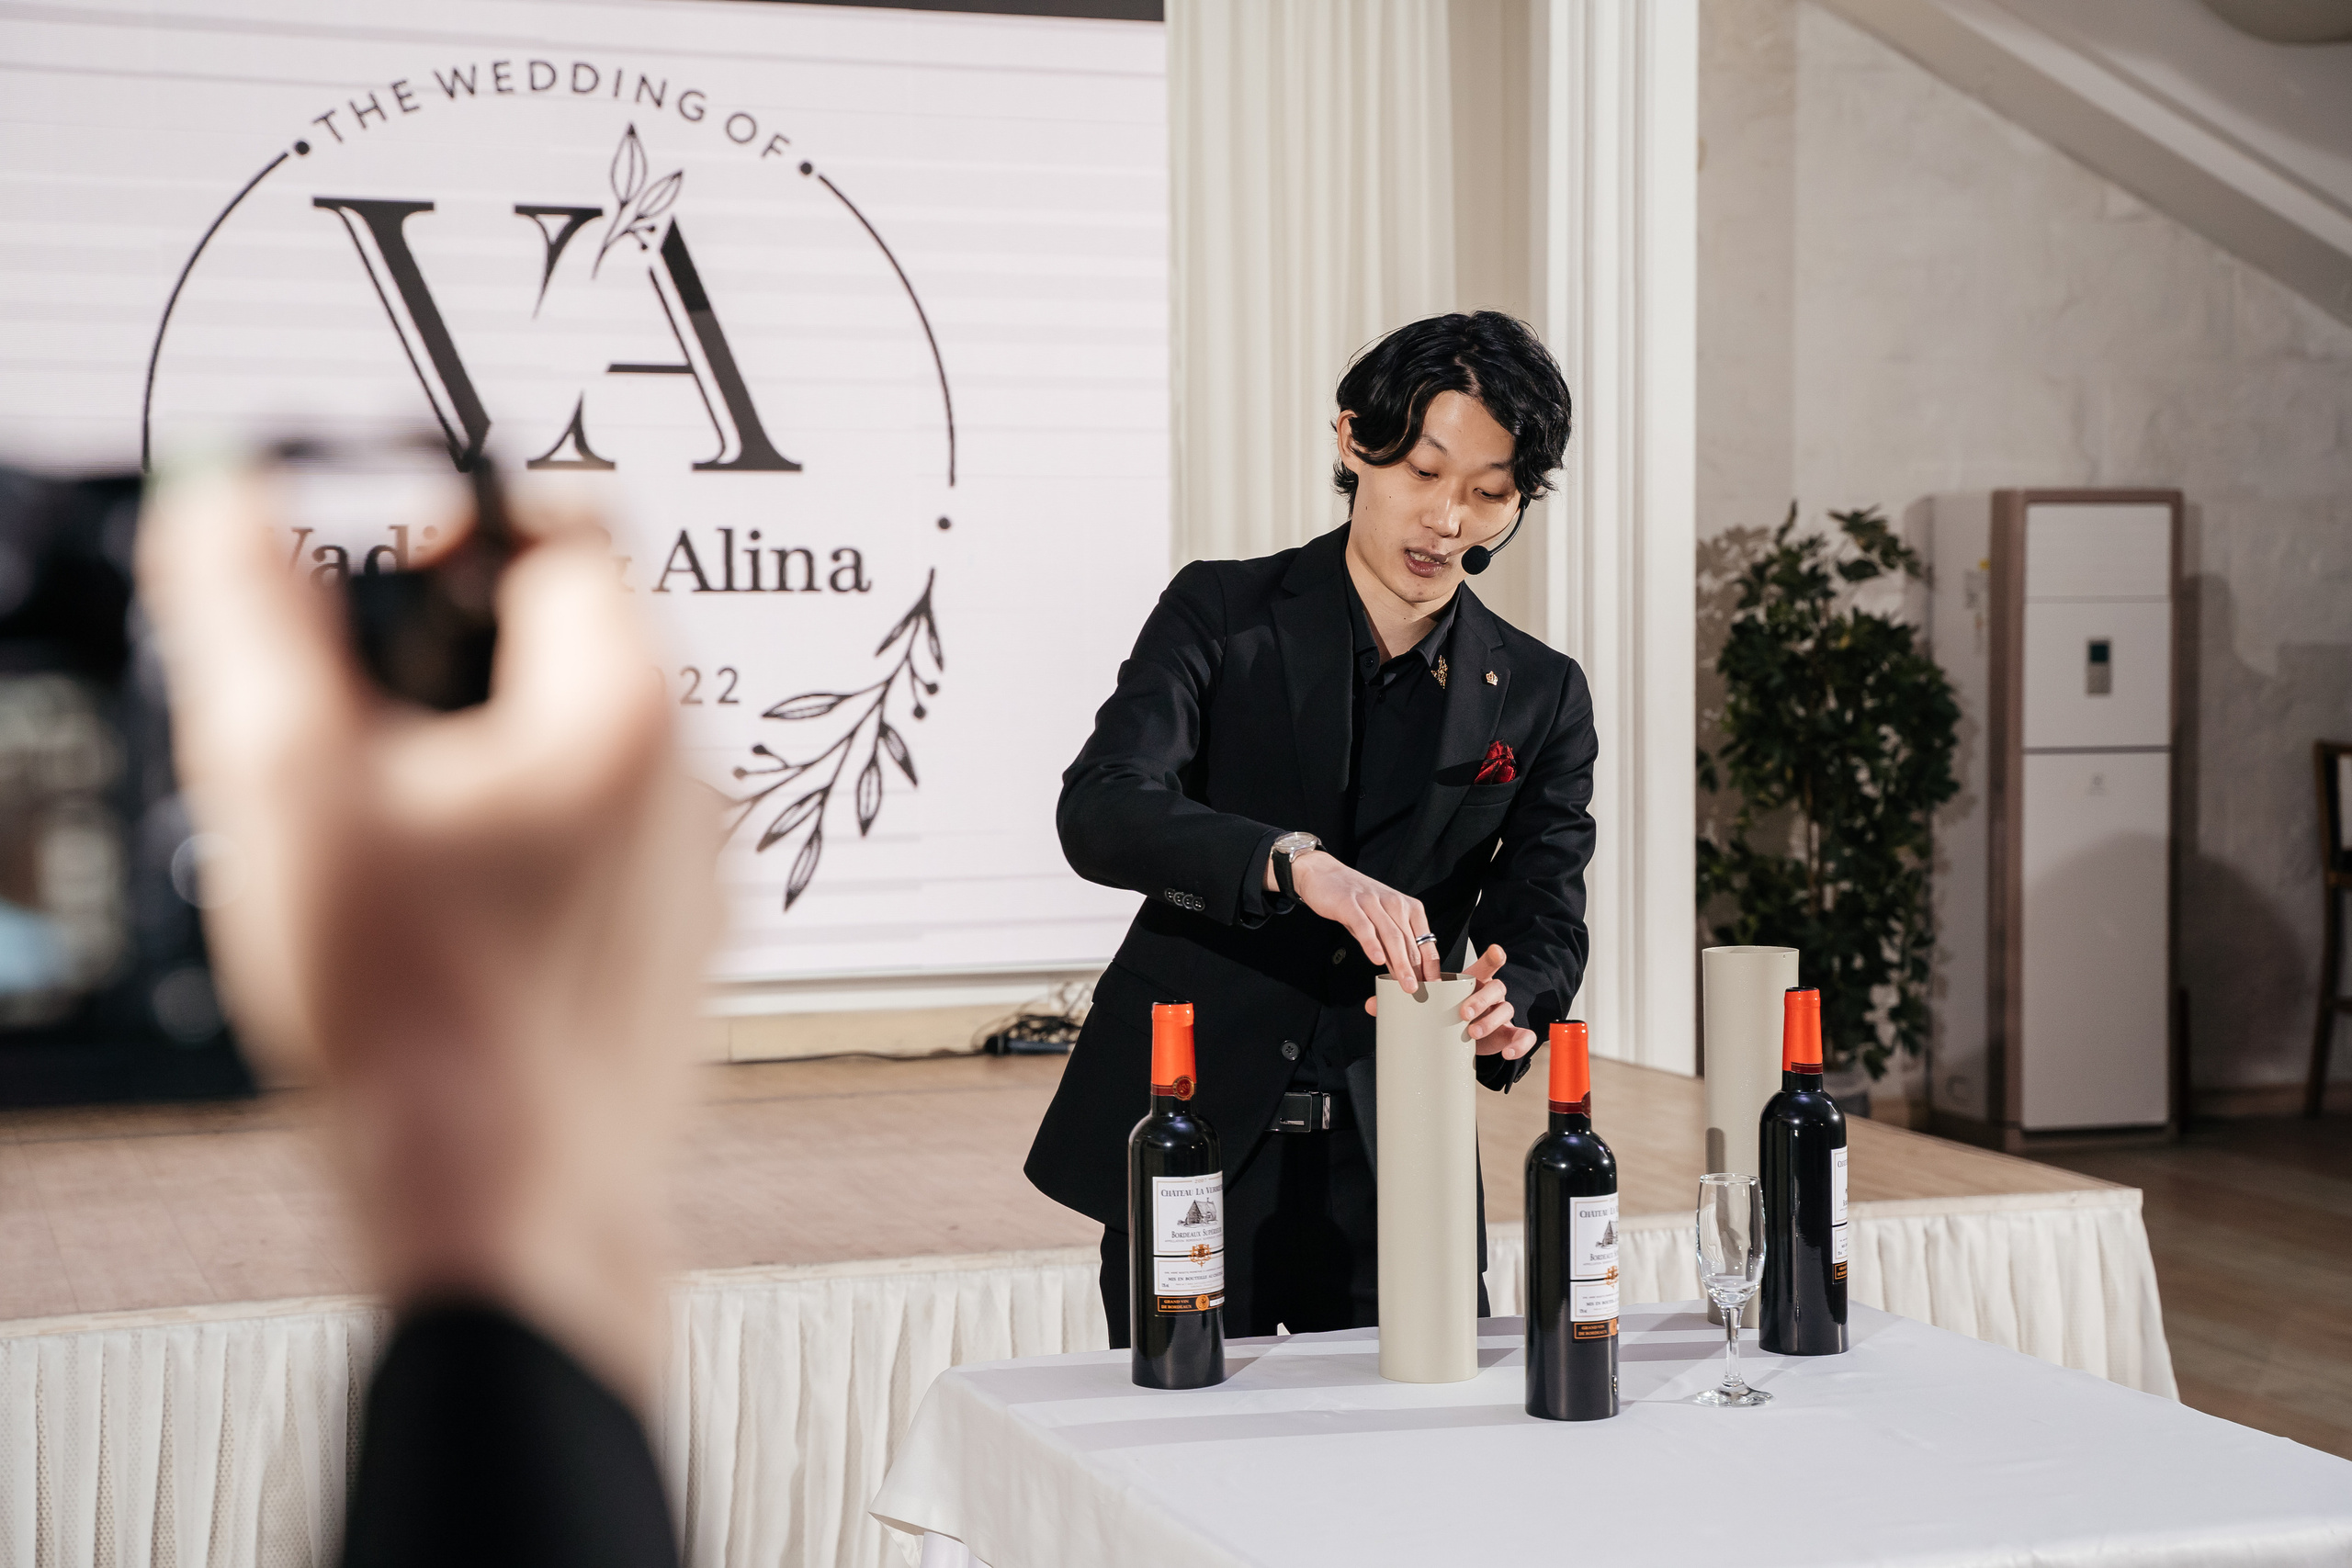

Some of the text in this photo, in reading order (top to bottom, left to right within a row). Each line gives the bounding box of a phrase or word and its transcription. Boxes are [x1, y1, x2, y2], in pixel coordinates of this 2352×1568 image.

[313, 60, 791, 159] THE WEDDING OF
[650, 526, 873, 593] Alina
